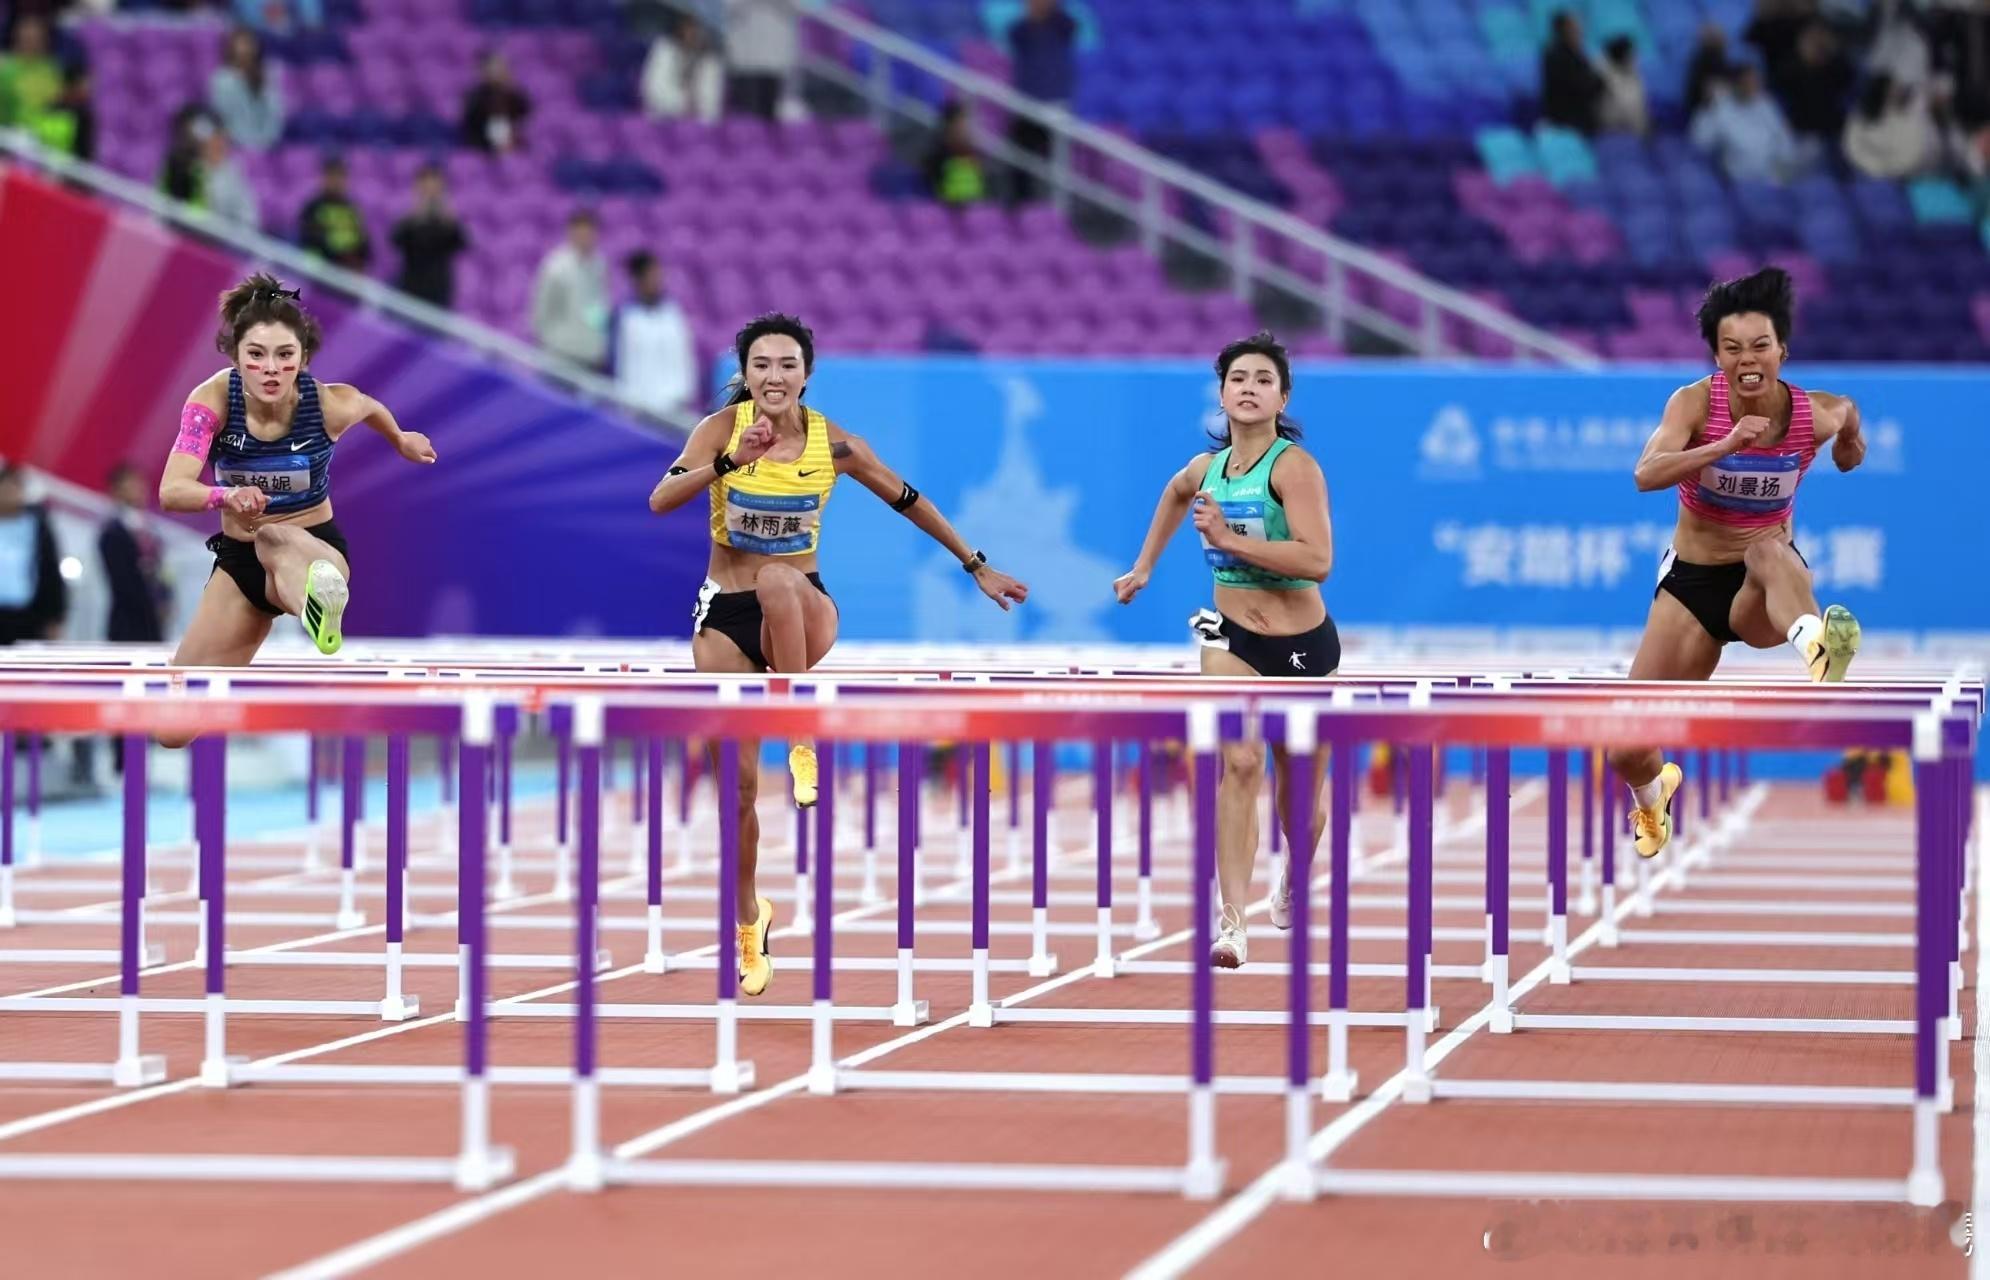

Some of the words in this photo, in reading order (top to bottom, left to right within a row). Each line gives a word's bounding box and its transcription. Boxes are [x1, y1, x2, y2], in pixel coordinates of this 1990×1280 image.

[1715, 474, 1781, 497] 刘景扬
[741, 512, 802, 536] 林雨薇
